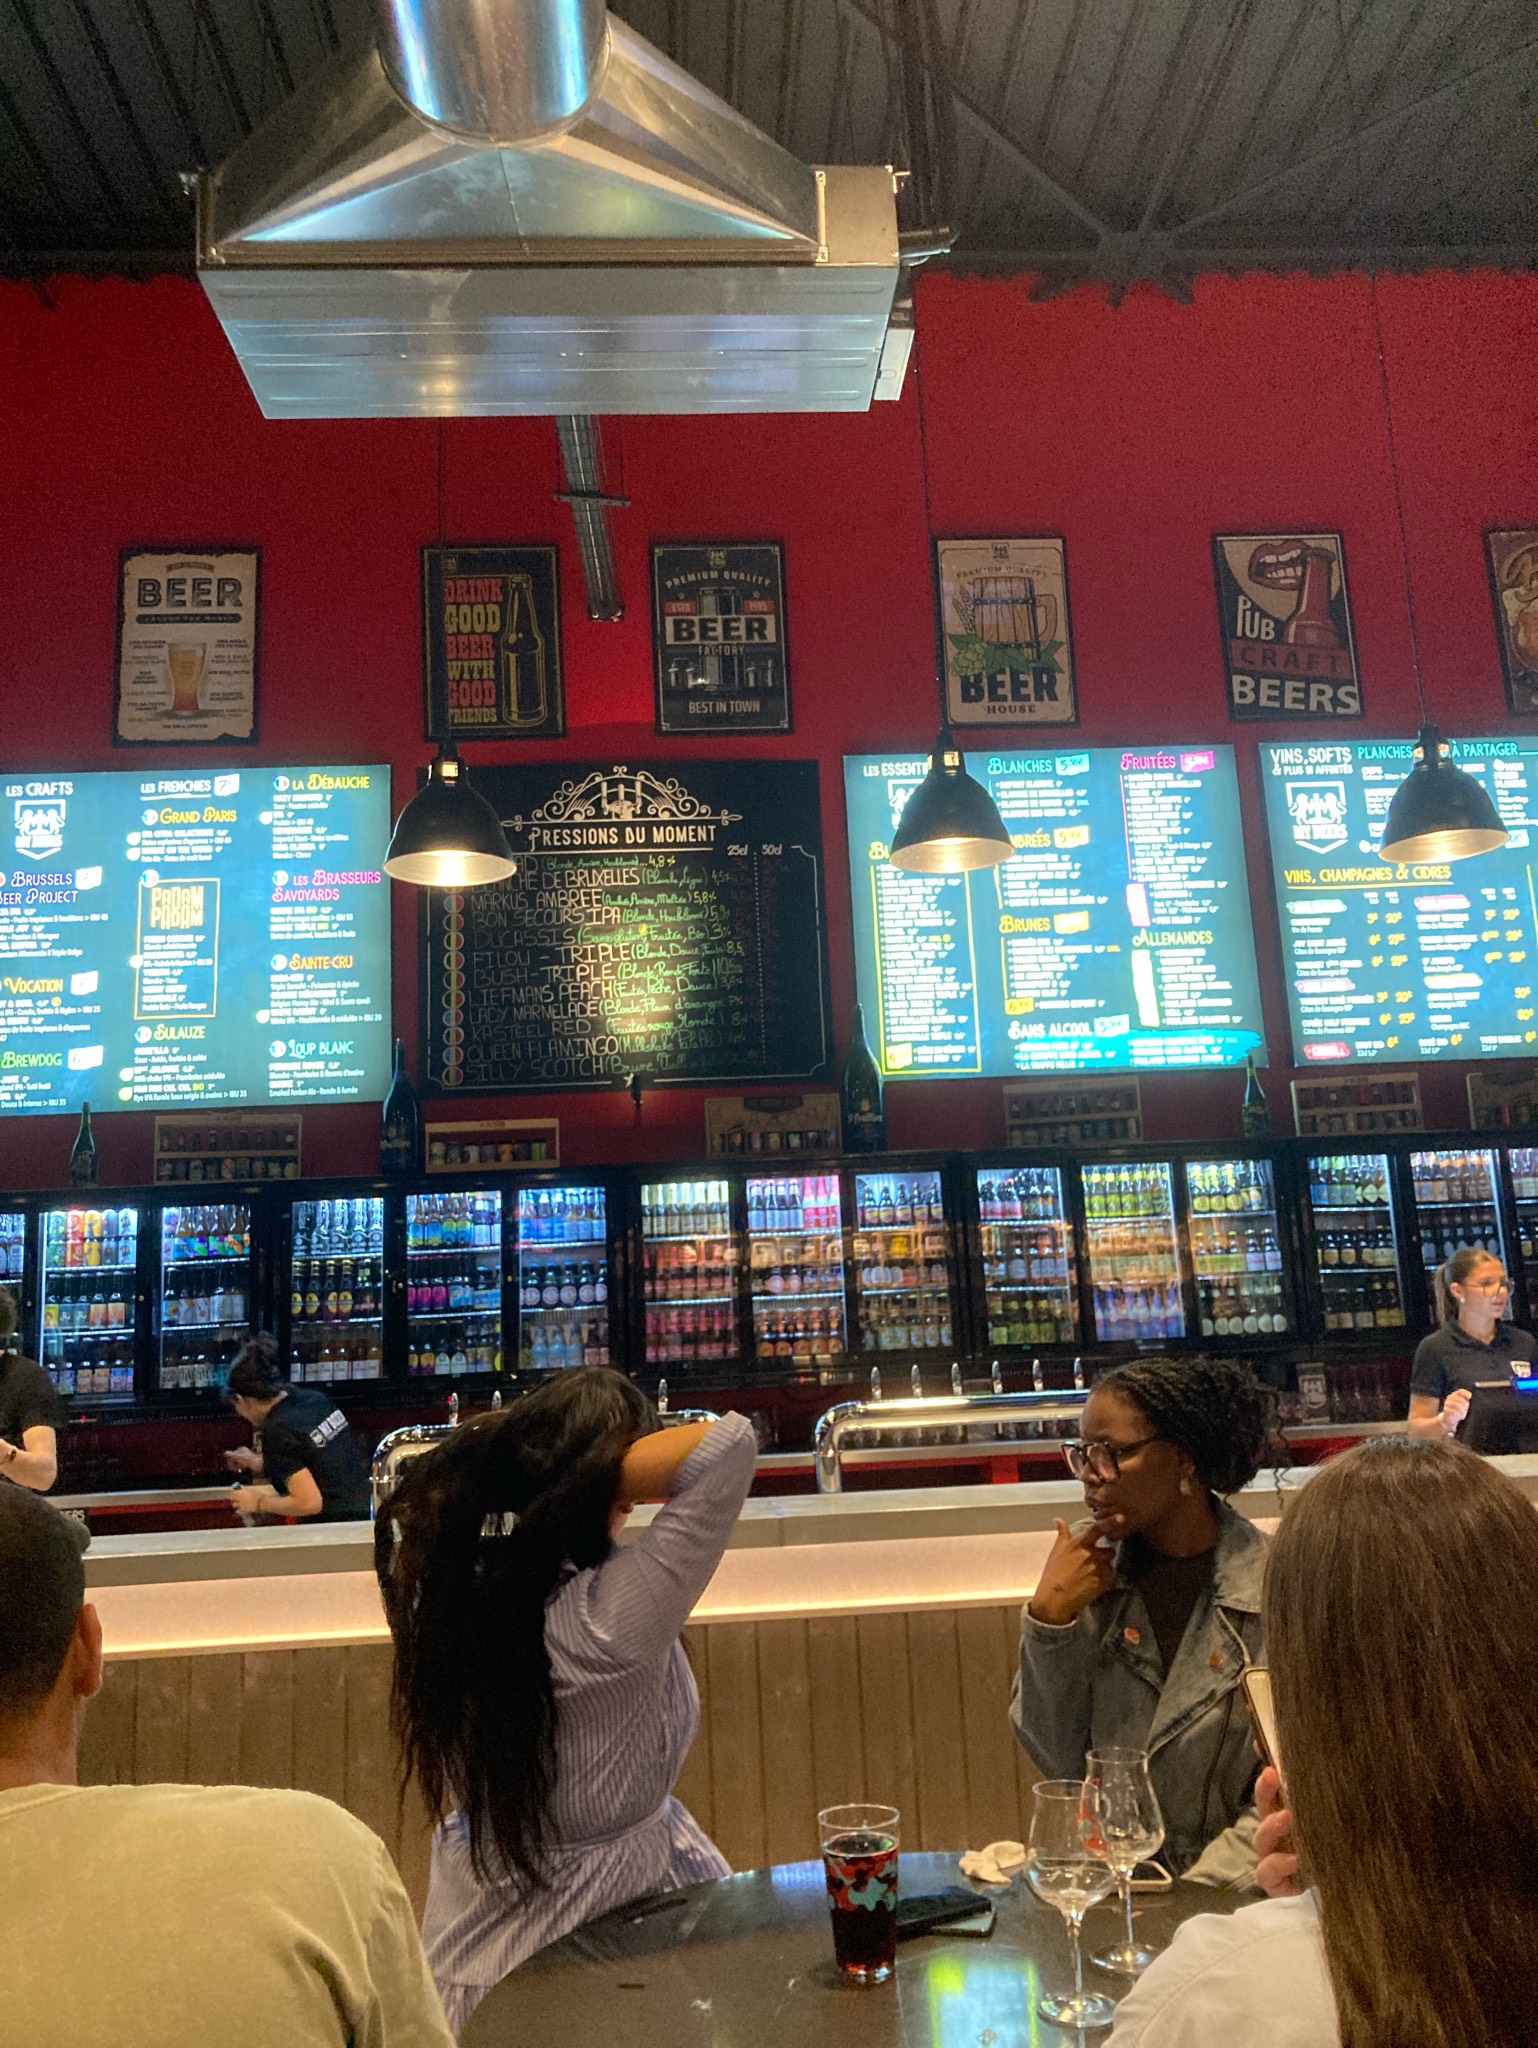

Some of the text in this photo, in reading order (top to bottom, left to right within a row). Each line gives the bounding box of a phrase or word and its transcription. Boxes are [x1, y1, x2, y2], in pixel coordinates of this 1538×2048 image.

[665, 570, 771, 588] PREMIUM QUALITY
[137, 577, 243, 608] BEER
[445, 579, 503, 603] DRINK
[445, 603, 500, 633] GOOD
[1236, 594, 1275, 641] PUB
[672, 616, 768, 643] BEER
[447, 634, 495, 659] BEER
[698, 645, 744, 656] FACTORY
[1239, 648, 1339, 675] CRAFT
[960, 666, 1059, 704] BEER
[1232, 674, 1361, 715] BEERS
[688, 701, 760, 714] BEST IN TOWN
[985, 704, 1036, 715] HOUSE
[1357, 745, 1413, 760] PLANCHES
[1463, 742, 1518, 758] PARTAGER
[987, 757, 1053, 775] BLANCHES
[1120, 751, 1176, 771] FRUITÉES
[1284, 765, 1304, 776] PLUS
[863, 765, 880, 777] LES
[6, 781, 74, 797] LES CRAFTS
[141, 779, 212, 794] LES FRENCHIES
[292, 773, 370, 791] LA DÉBAUCHE
[160, 806, 238, 825] GRAND PARIS
[528, 825, 717, 852] PRESSIONS DU MOMENT
[1009, 827, 1052, 849] MBRÉES
[11, 870, 72, 888] BRUSSELS
[293, 869, 381, 886] LES BRASSEURS
[1319, 867, 1393, 883] CHAMPAGNES
[1412, 864, 1453, 880] CIDRES
[0, 887, 78, 905] EER PROJECT
[272, 886, 340, 903] SAVOYARDS
[471, 891, 529, 912] MARKUS
[472, 911, 508, 930] BON
[511, 908, 585, 928] SECOURS
[586, 906, 621, 925] IPA
[999, 914, 1051, 934] BRUNES
[1132, 928, 1214, 947] ALLEMANDES
[289, 953, 353, 971] SAINTE-CRU
[473, 950, 531, 969] FILOU
[555, 943, 630, 963] TRIPLE
[4, 976, 64, 994] VOCATION
[468, 985, 554, 1007] LIEFMANS
[558, 980, 613, 1002] PEACH
[469, 1007, 508, 1025] LADY
[513, 1001, 598, 1022] MARMELADE
[153, 1023, 206, 1041] SULAUZE
[552, 1018, 592, 1036] RED
[1007, 1020, 1046, 1040] SANS
[1048, 1021, 1092, 1039] ALCOOL
[288, 1039, 354, 1059] LOUP BLANC
[467, 1044, 521, 1063] QUEEN
[528, 1036, 619, 1059] FLAMINGO
[1, 1051, 62, 1068] BREWDOG
[530, 1056, 604, 1079] SCOTCH
